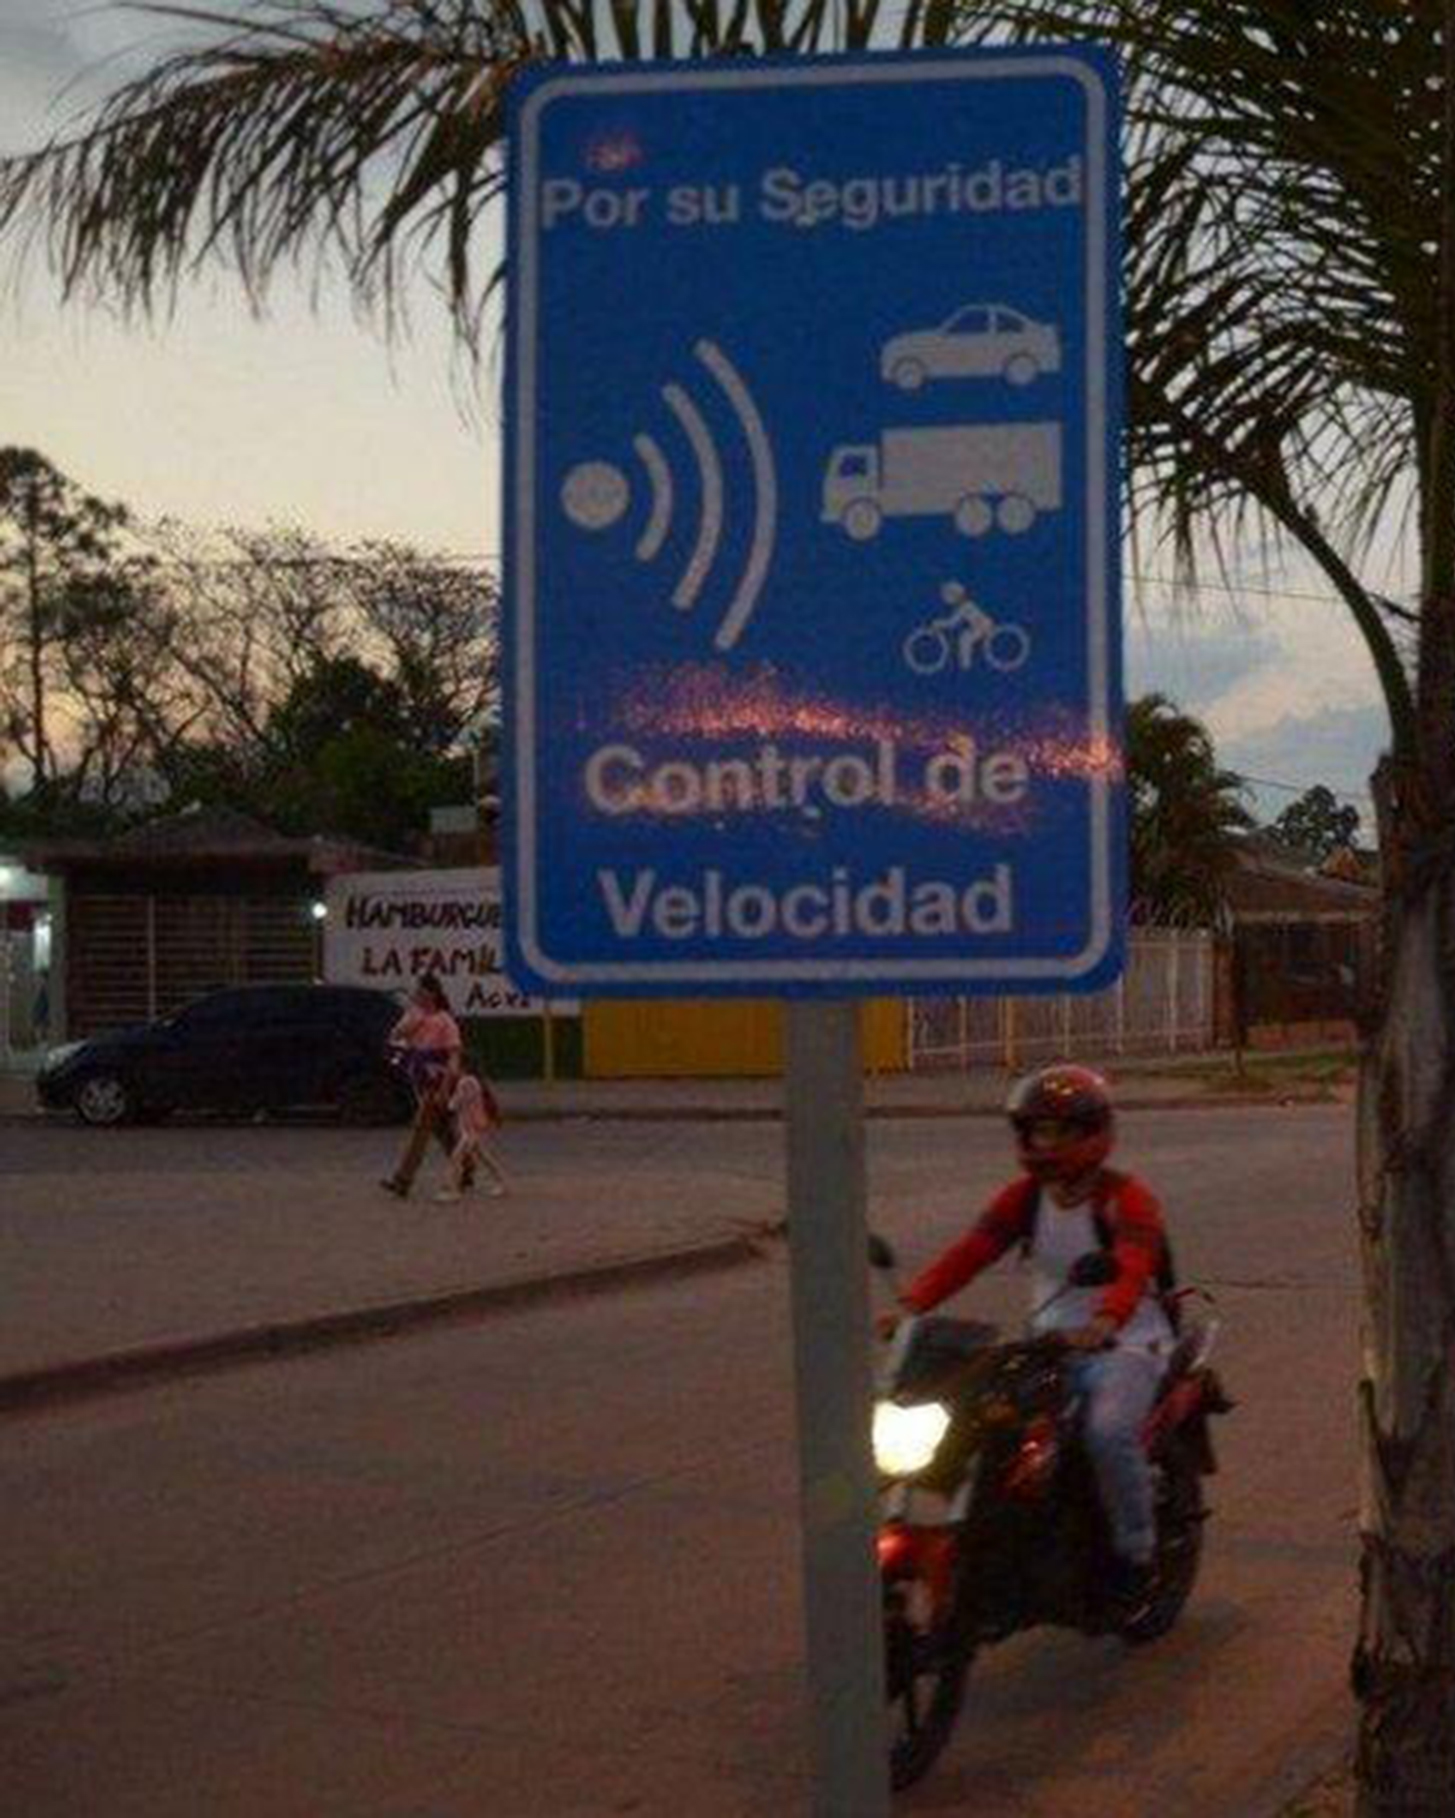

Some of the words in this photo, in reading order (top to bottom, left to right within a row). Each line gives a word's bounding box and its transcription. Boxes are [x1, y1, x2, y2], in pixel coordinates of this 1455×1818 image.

[541, 178, 649, 229] Por
[667, 185, 739, 223] su
[761, 154, 1082, 229] Seguridad
[585, 742, 895, 815] Control
[925, 735, 1028, 802] de
[598, 863, 1013, 939] Velocidad
[362, 947, 404, 976] LA
